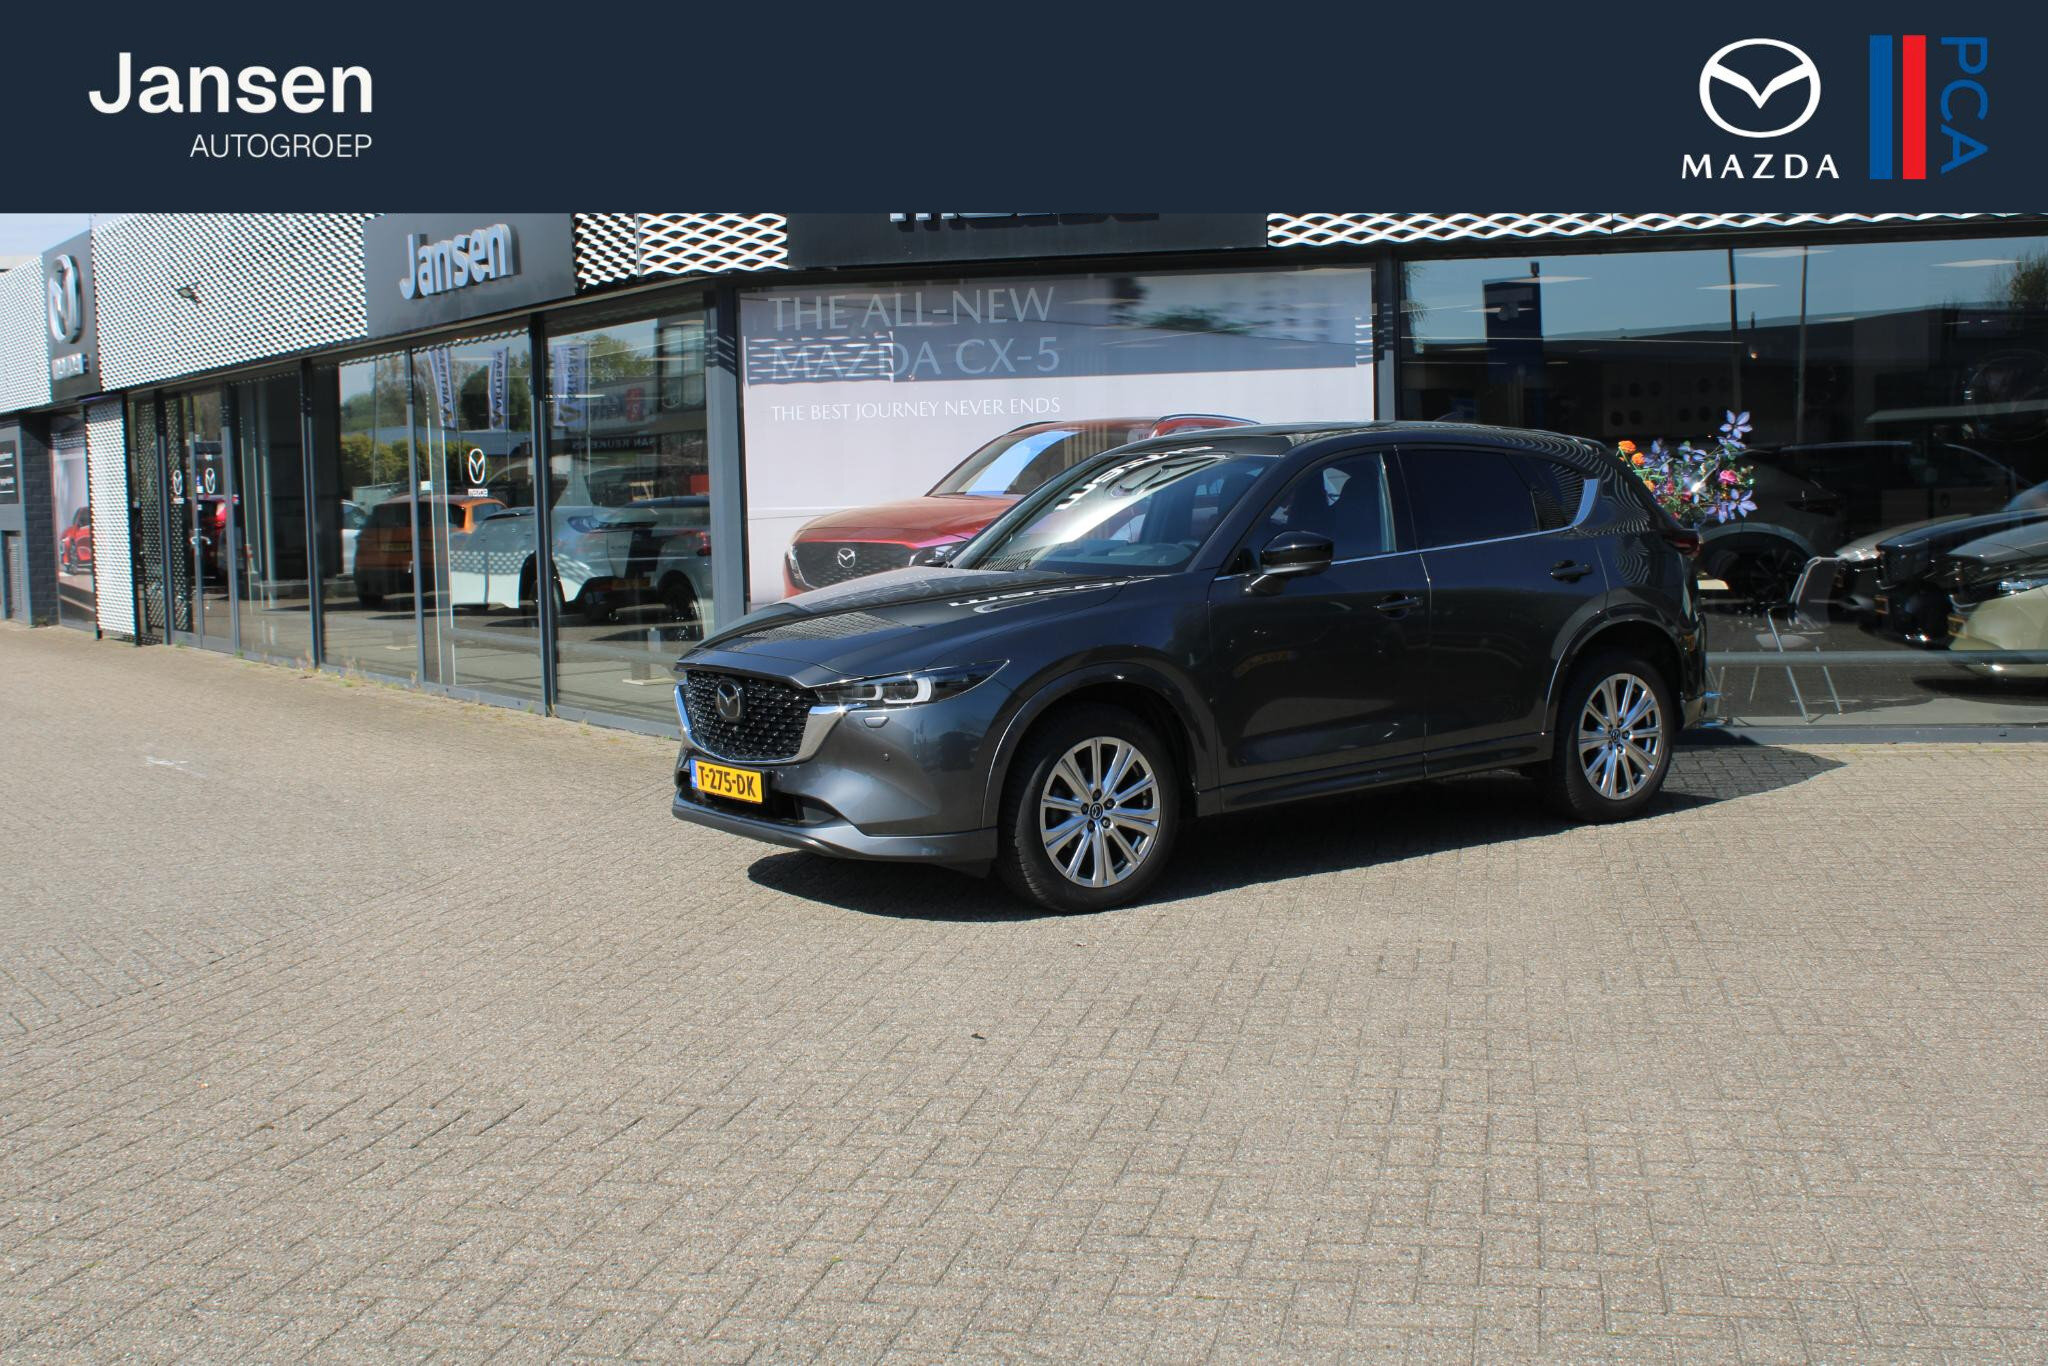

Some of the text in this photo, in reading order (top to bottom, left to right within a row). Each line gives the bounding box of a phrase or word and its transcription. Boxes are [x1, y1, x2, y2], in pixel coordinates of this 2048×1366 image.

[399, 223, 513, 300] Jansen
[767, 286, 1055, 332] THE ALL-NEW
[771, 336, 1060, 380] MAZDA CX-5
[770, 397, 1061, 422] THE BEST JOURNEY NEVER ENDS
[698, 765, 756, 797] T-275-DK
